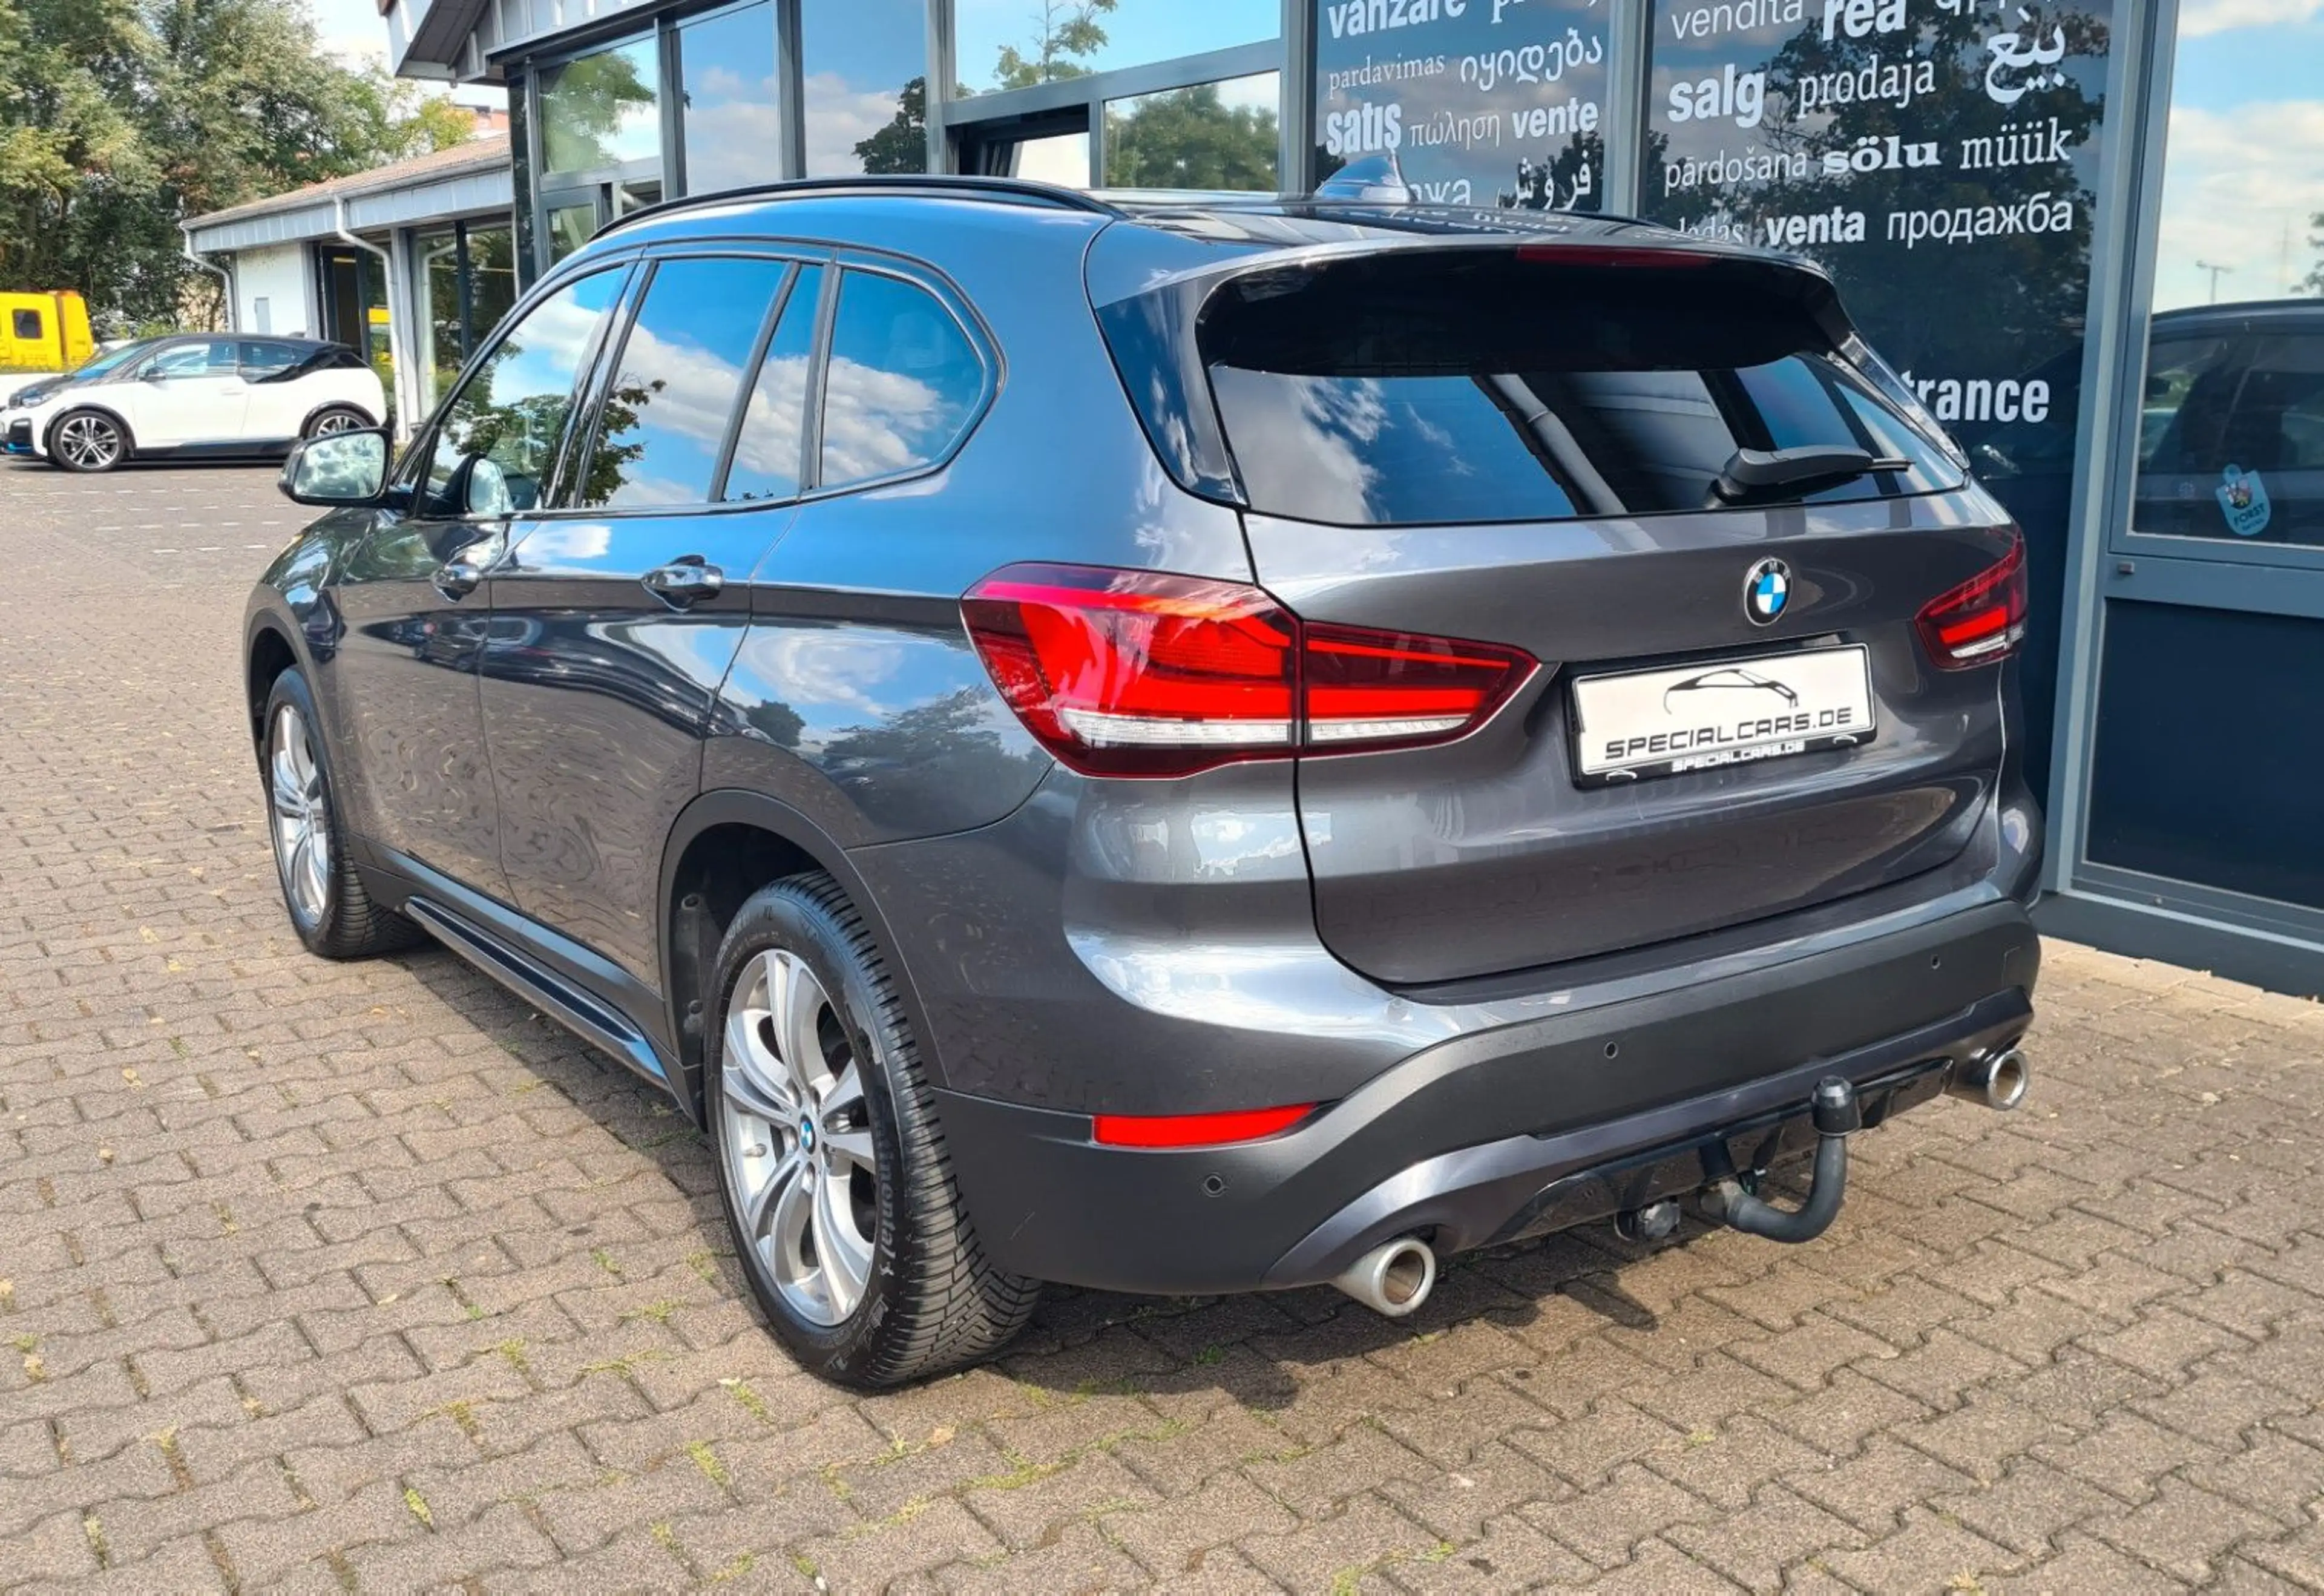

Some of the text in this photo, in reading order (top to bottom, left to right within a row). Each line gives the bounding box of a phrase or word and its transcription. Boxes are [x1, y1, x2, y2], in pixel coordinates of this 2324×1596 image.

[1671, 0, 1803, 39] vendita
[1328, 52, 1445, 100] pardavimas
[1460, 27, 1603, 91] იყიდება
[1667, 48, 1936, 128] salg prodaja
[1409, 111, 1501, 150] πώληση
[1512, 97, 1599, 139] vente
[1664, 116, 2073, 198] pārdošana sölu müük
[1765, 206, 1866, 246] venta
[1887, 191, 2074, 250] продажба
[1604, 706, 1853, 760] SPECIALCARS.DE
